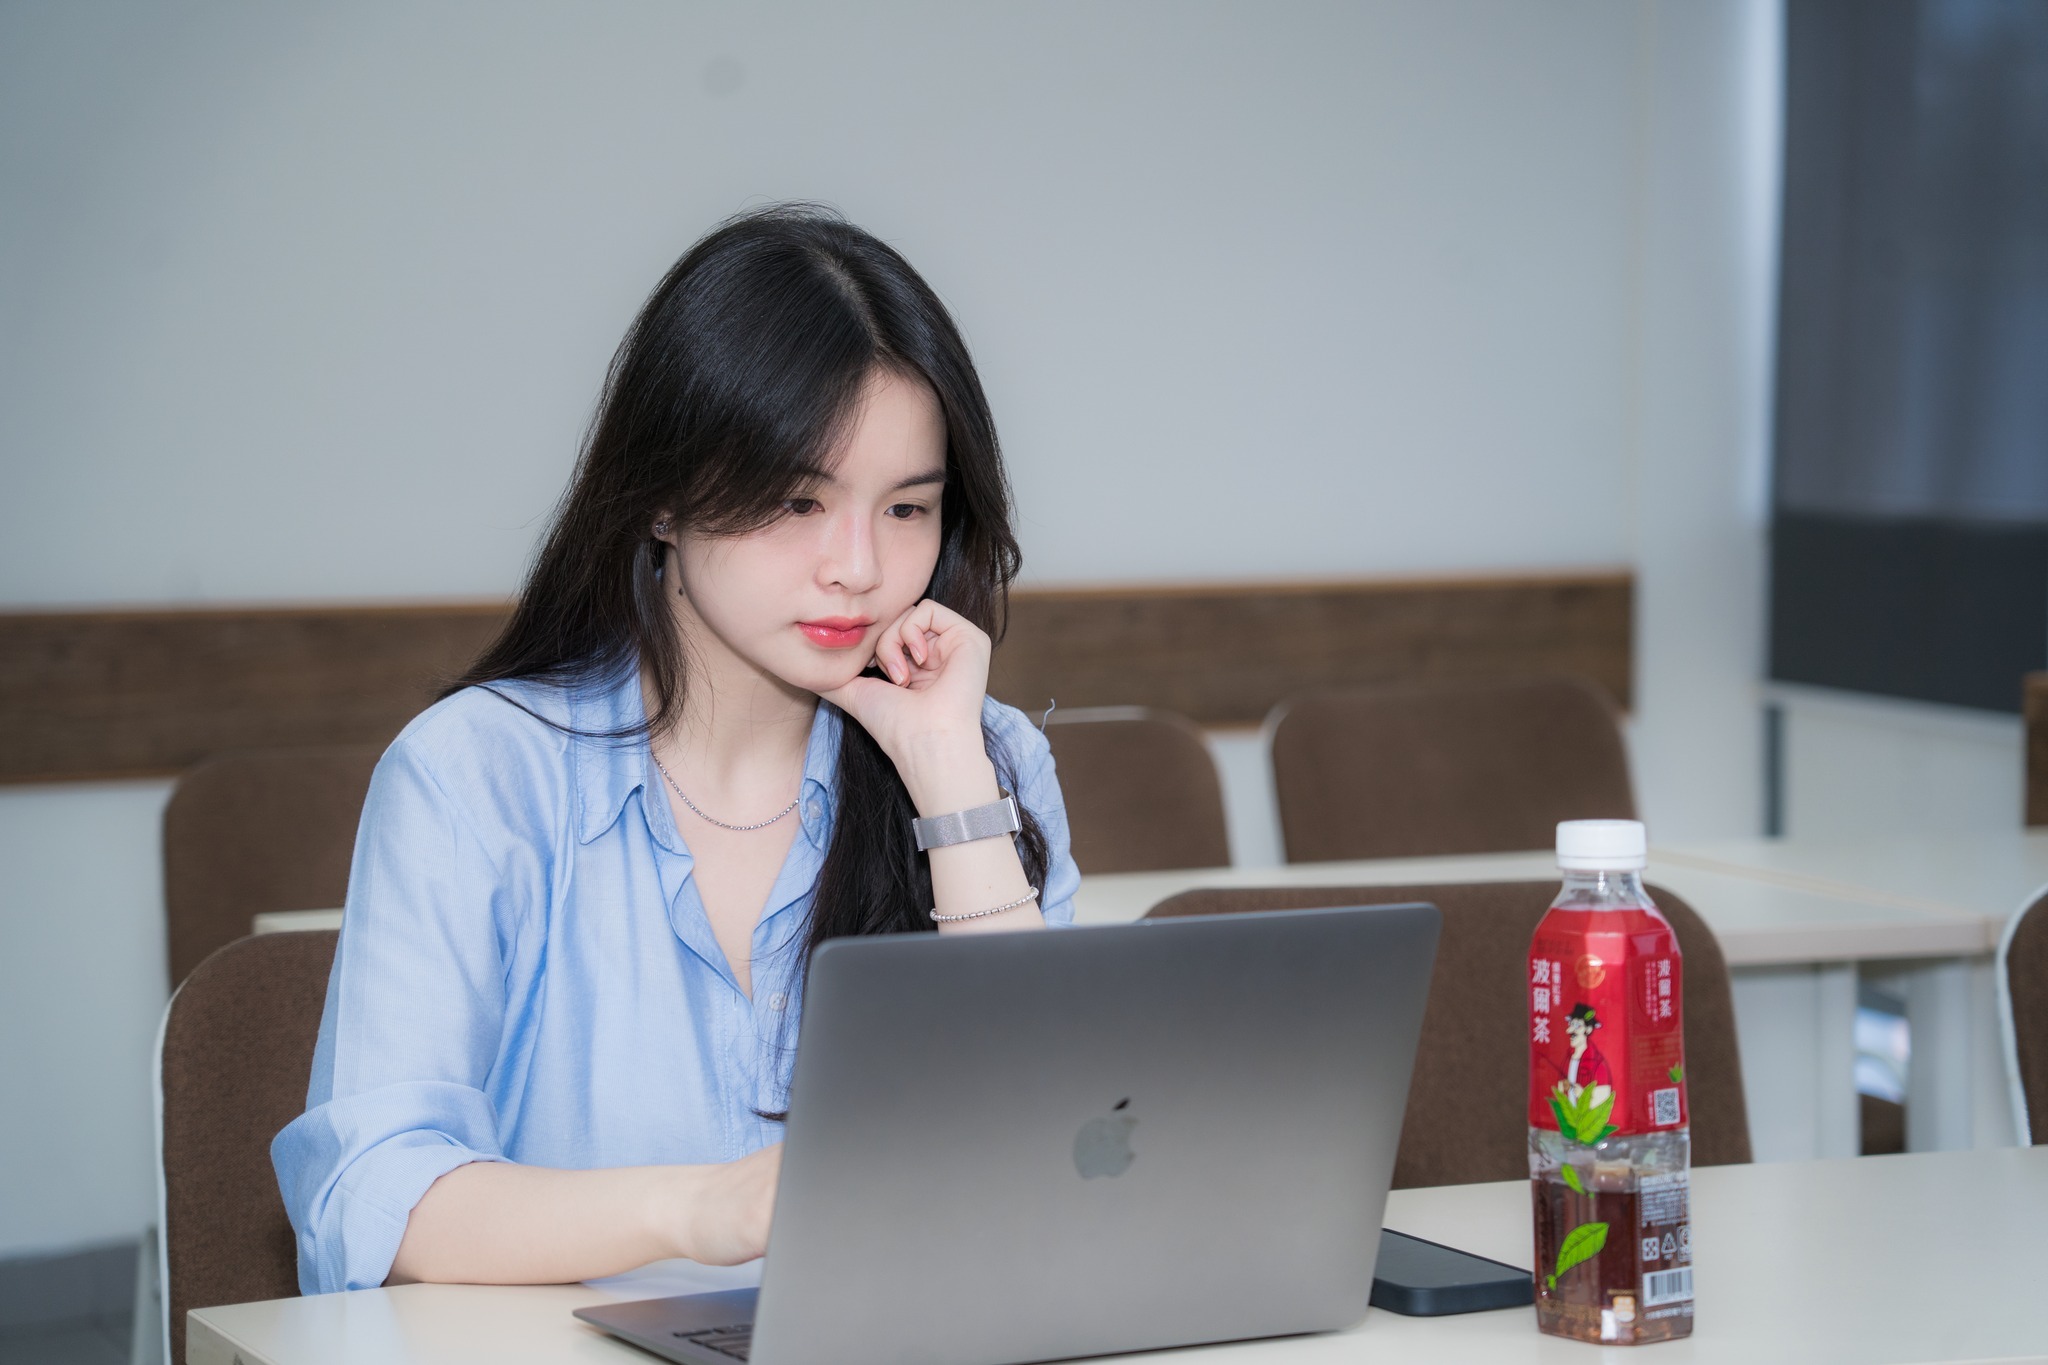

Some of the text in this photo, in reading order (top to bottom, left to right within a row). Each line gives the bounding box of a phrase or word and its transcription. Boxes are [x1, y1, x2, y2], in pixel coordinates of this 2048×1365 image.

[1532, 958, 1550, 1043] 波爾茶
[1657, 959, 1672, 1017] 波爾茶
